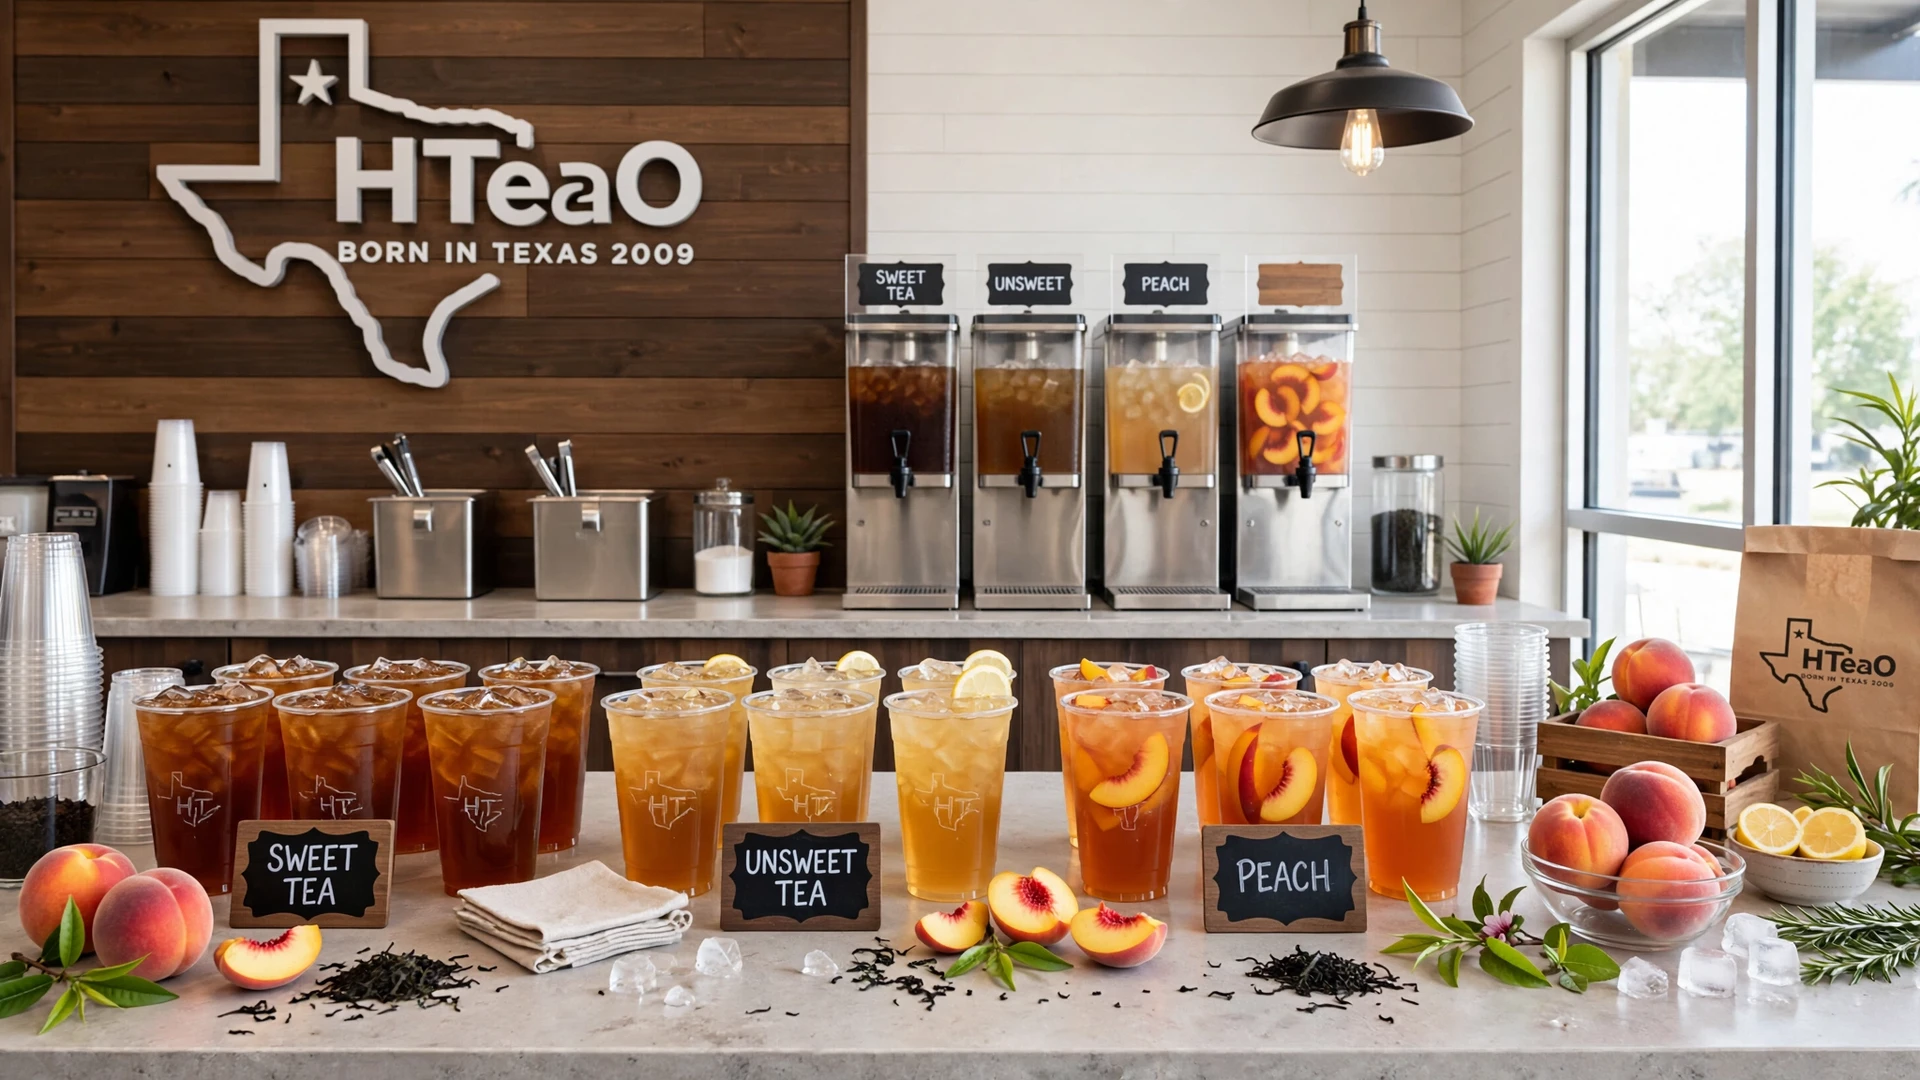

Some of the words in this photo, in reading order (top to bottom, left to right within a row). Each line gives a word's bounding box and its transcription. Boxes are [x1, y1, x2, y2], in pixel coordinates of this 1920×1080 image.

[336, 137, 702, 227] HTeaO
[337, 241, 429, 263] BORN
[445, 241, 478, 263] IN
[492, 242, 598, 264] TEXAS
[611, 242, 695, 265] 2009
[876, 269, 926, 285] SWEET
[995, 276, 1065, 291] UNSWEET
[1141, 276, 1190, 292] PEACH
[886, 286, 915, 301] TEA
[1802, 648, 1896, 677] HTeaO
[1801, 673, 1824, 681] BORN
[1840, 677, 1868, 685] TEXAS
[1871, 680, 1894, 688] 2009
[267, 842, 359, 873] SWEET
[745, 848, 858, 875] UNSWEET
[1236, 858, 1331, 893] PEACH
[283, 876, 337, 906] TEA
[774, 879, 828, 907] TEA
